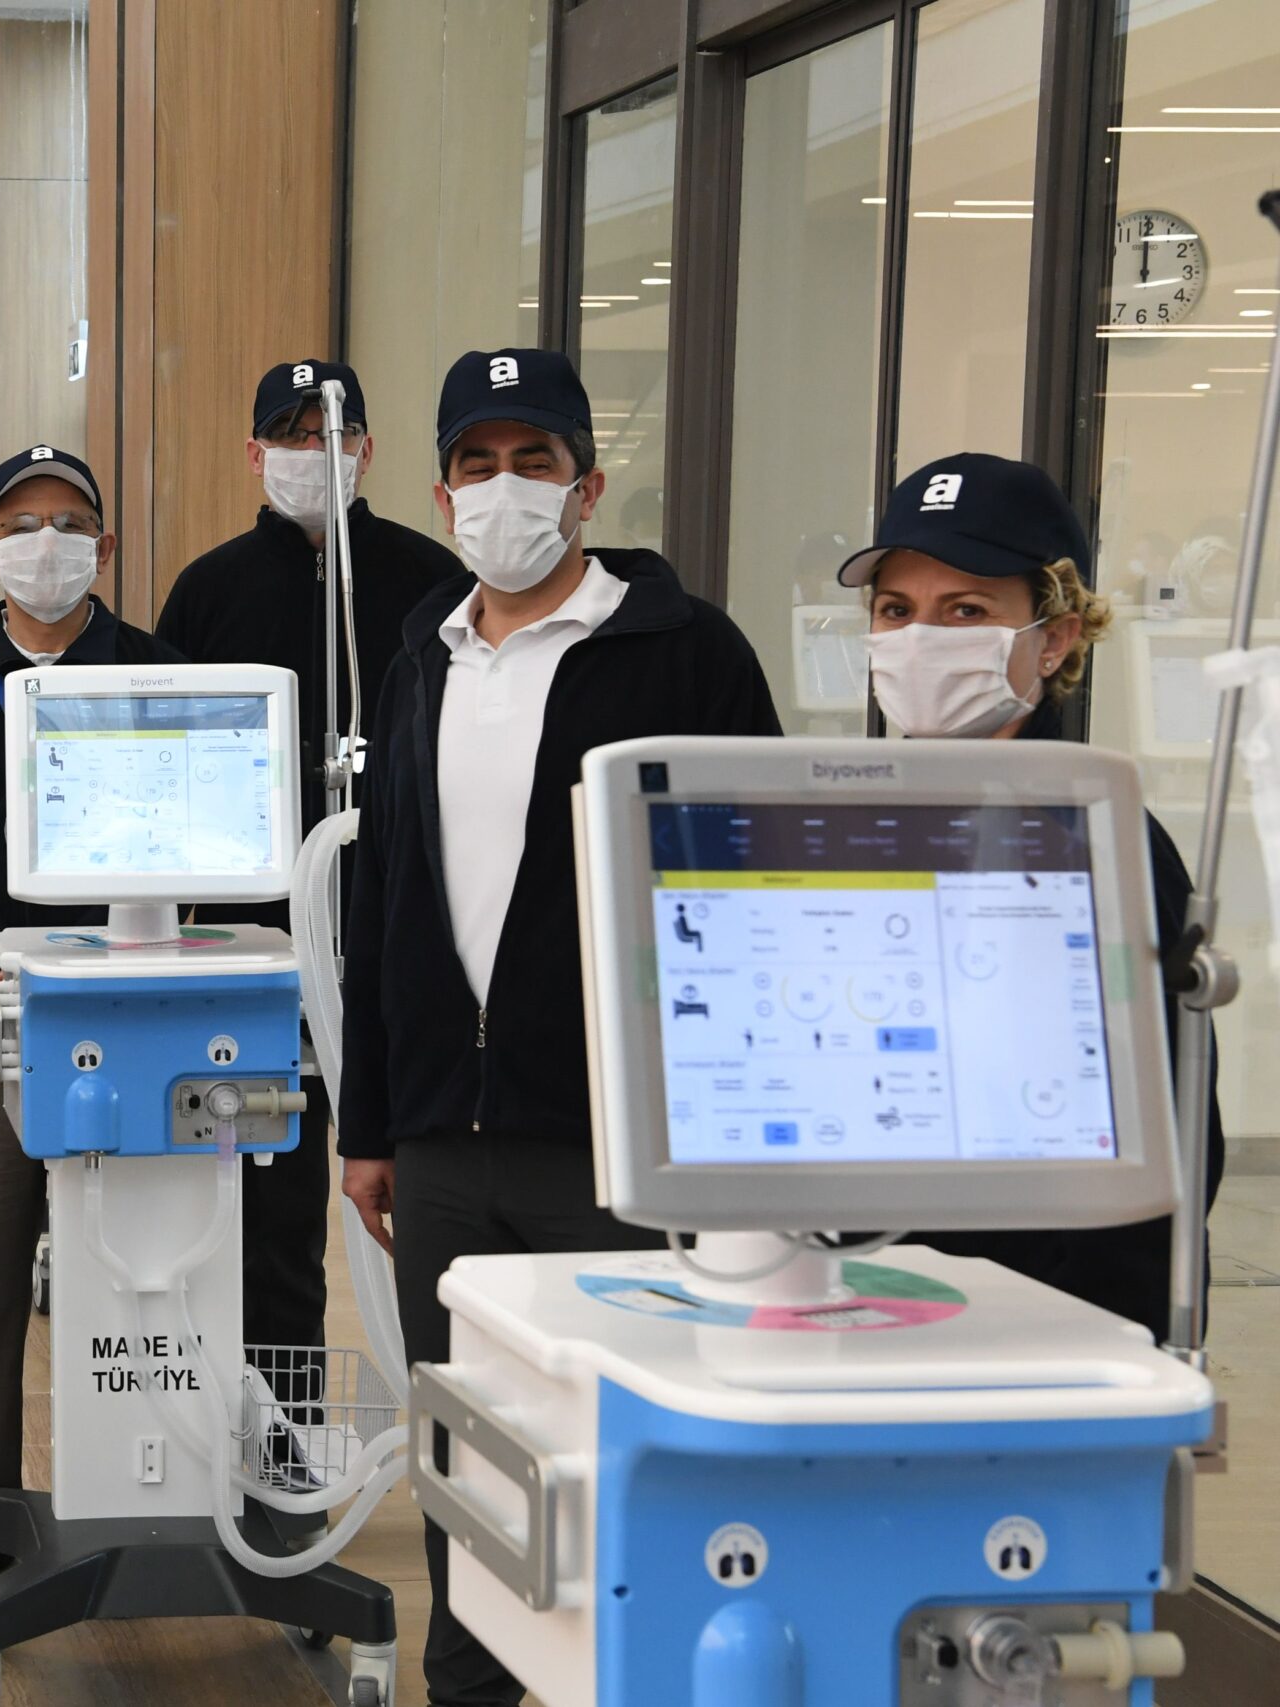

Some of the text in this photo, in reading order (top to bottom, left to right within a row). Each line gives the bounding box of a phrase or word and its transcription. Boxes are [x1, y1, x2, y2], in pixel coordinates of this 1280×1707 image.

[1119, 228, 1130, 243] 11
[1176, 242, 1188, 258] 2
[1182, 265, 1193, 280] 3
[1174, 288, 1186, 302] 4
[1116, 303, 1127, 318] 7
[1136, 309, 1147, 324] 6
[1158, 303, 1169, 318] 5
[293, 364, 314, 385] a
[490, 356, 519, 383] a
[31, 447, 53, 460] a
[923, 473, 963, 504] a
[131, 677, 173, 687] biyovent
[812, 760, 895, 781] biyovent
